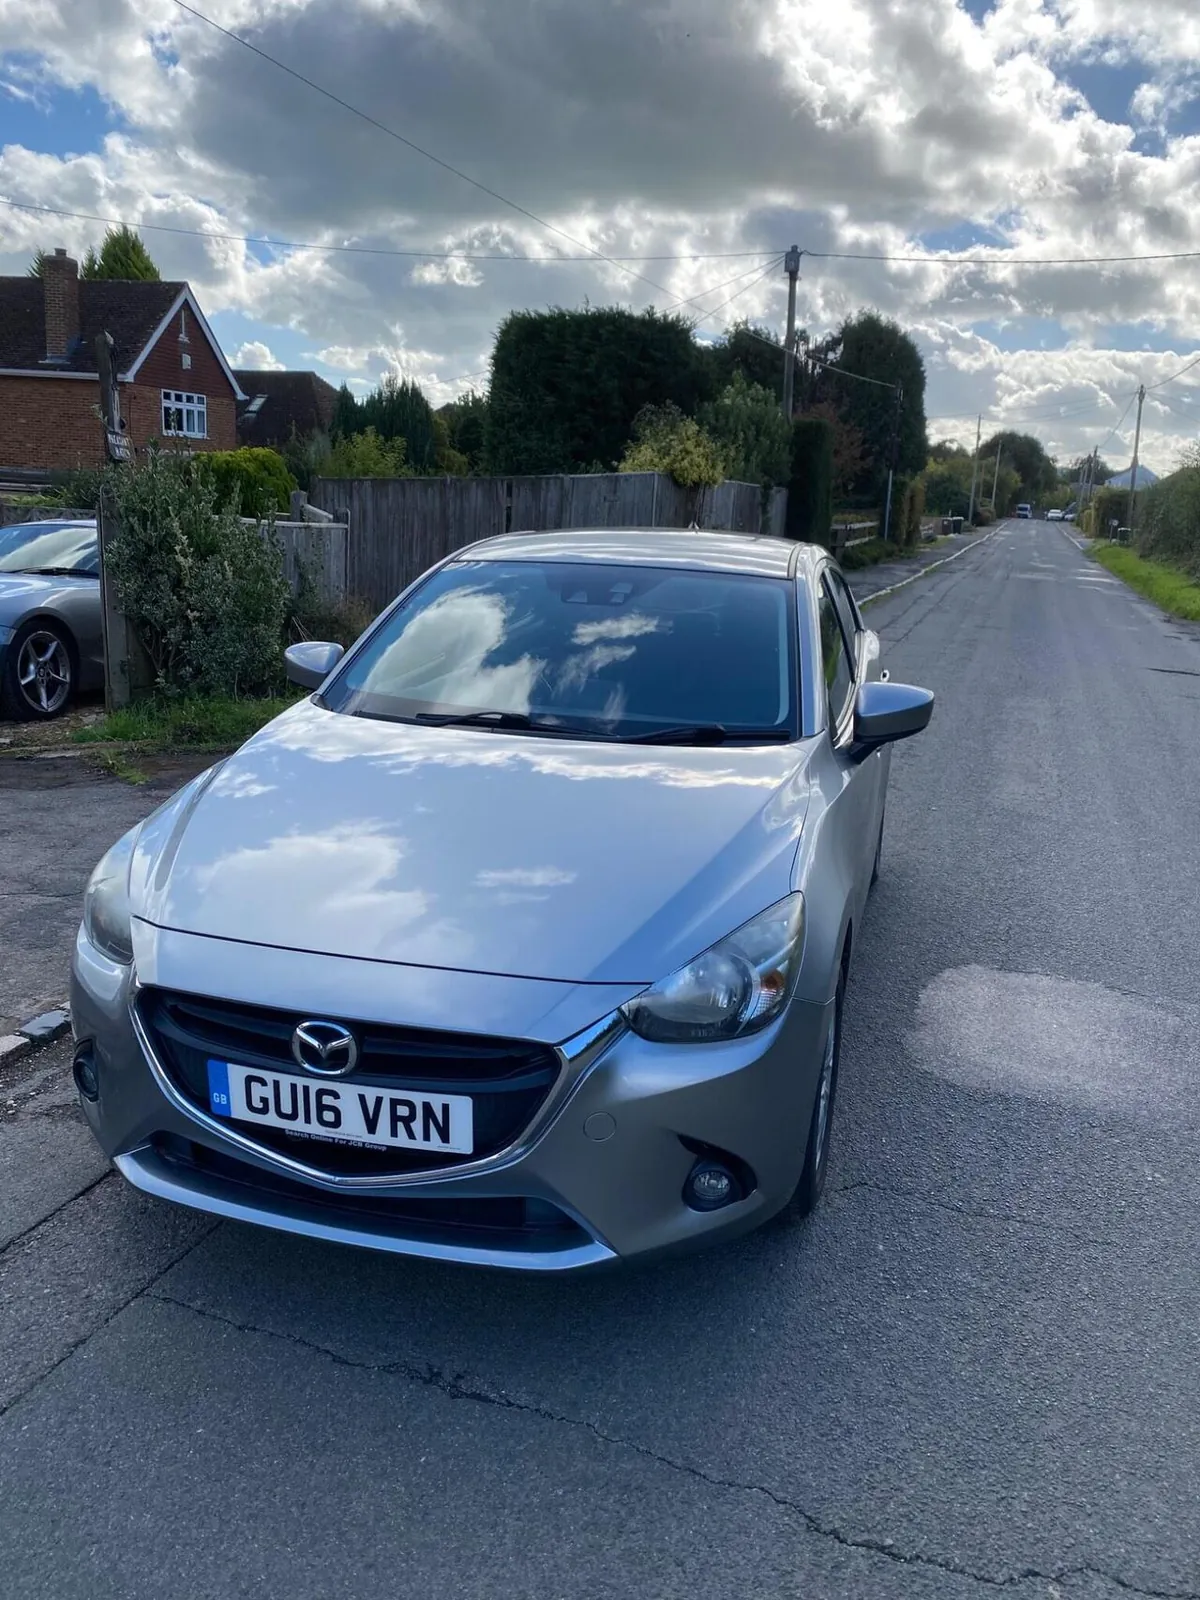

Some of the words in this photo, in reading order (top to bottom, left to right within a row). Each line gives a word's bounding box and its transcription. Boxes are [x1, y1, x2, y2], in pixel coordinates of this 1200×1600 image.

[213, 1092, 227, 1105] GB
[244, 1074, 342, 1129] GU16
[357, 1093, 450, 1144] VRN
[285, 1128, 309, 1139] Search
[310, 1133, 333, 1143] Online
[364, 1143, 387, 1152] Group
